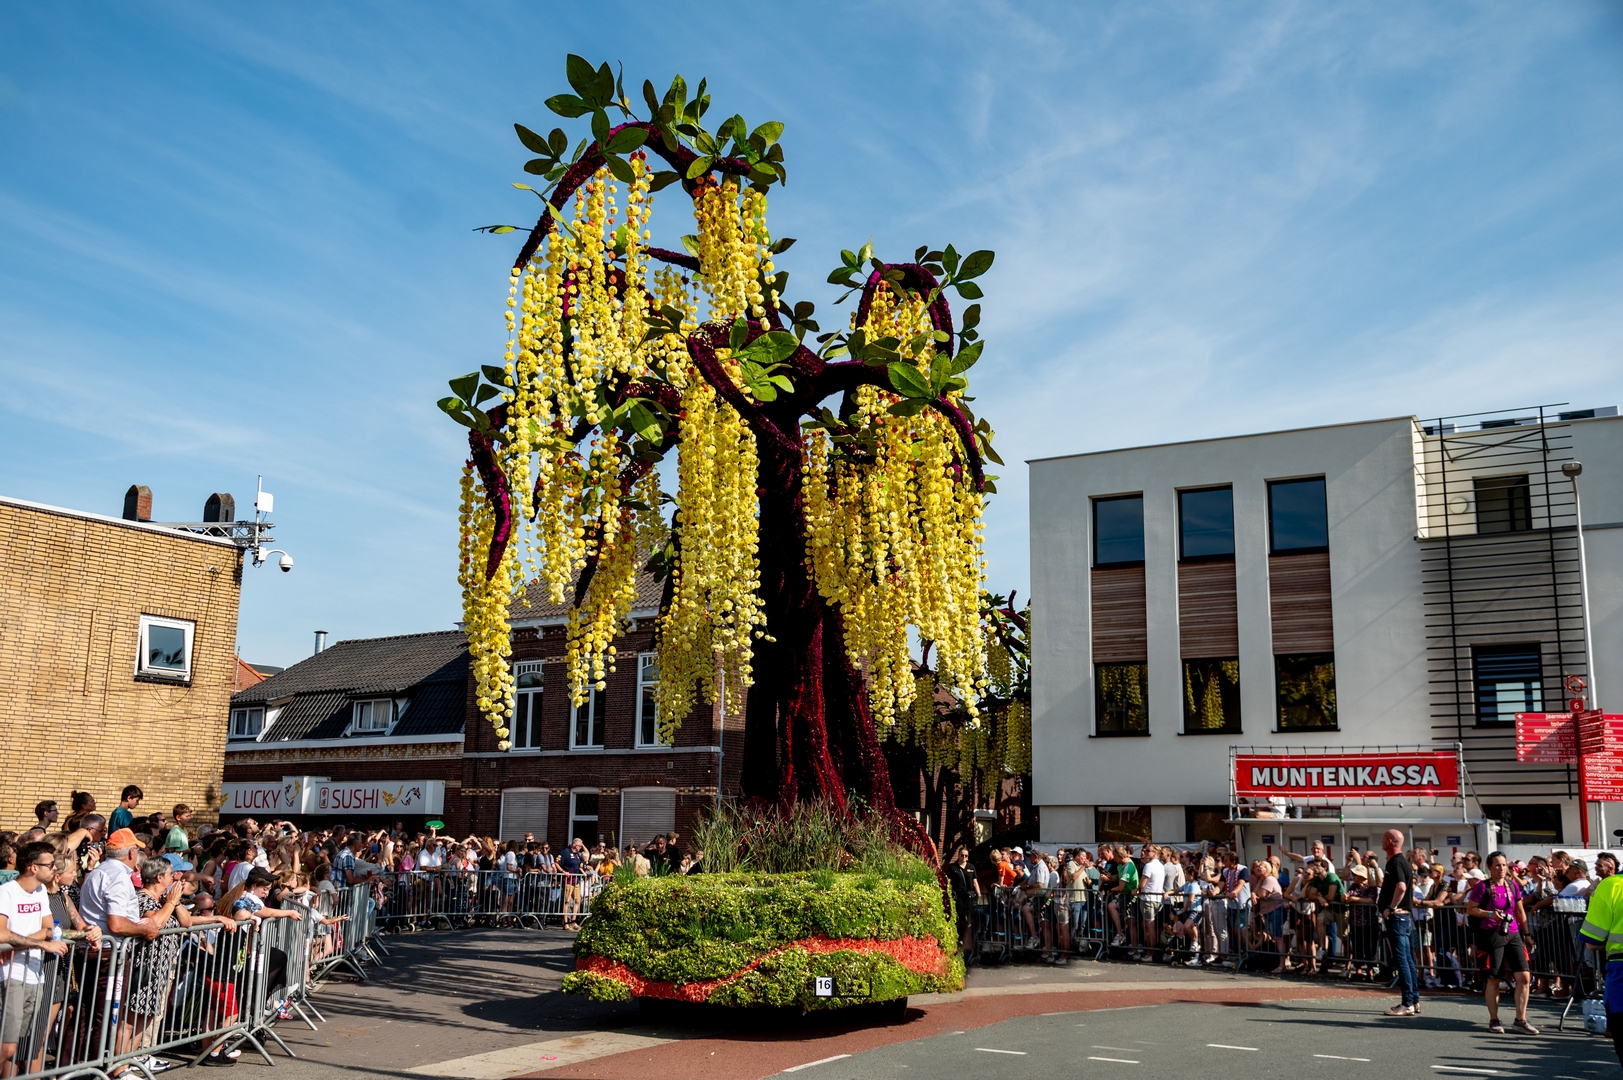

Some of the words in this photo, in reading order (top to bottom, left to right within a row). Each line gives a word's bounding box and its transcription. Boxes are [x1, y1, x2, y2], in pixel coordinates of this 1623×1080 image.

[1574, 702, 1580, 710] 6
[1251, 764, 1441, 787] MUNTENKASSA
[234, 789, 281, 809] LUCKY
[331, 788, 379, 809] SUSHI
[818, 980, 831, 989] 16
